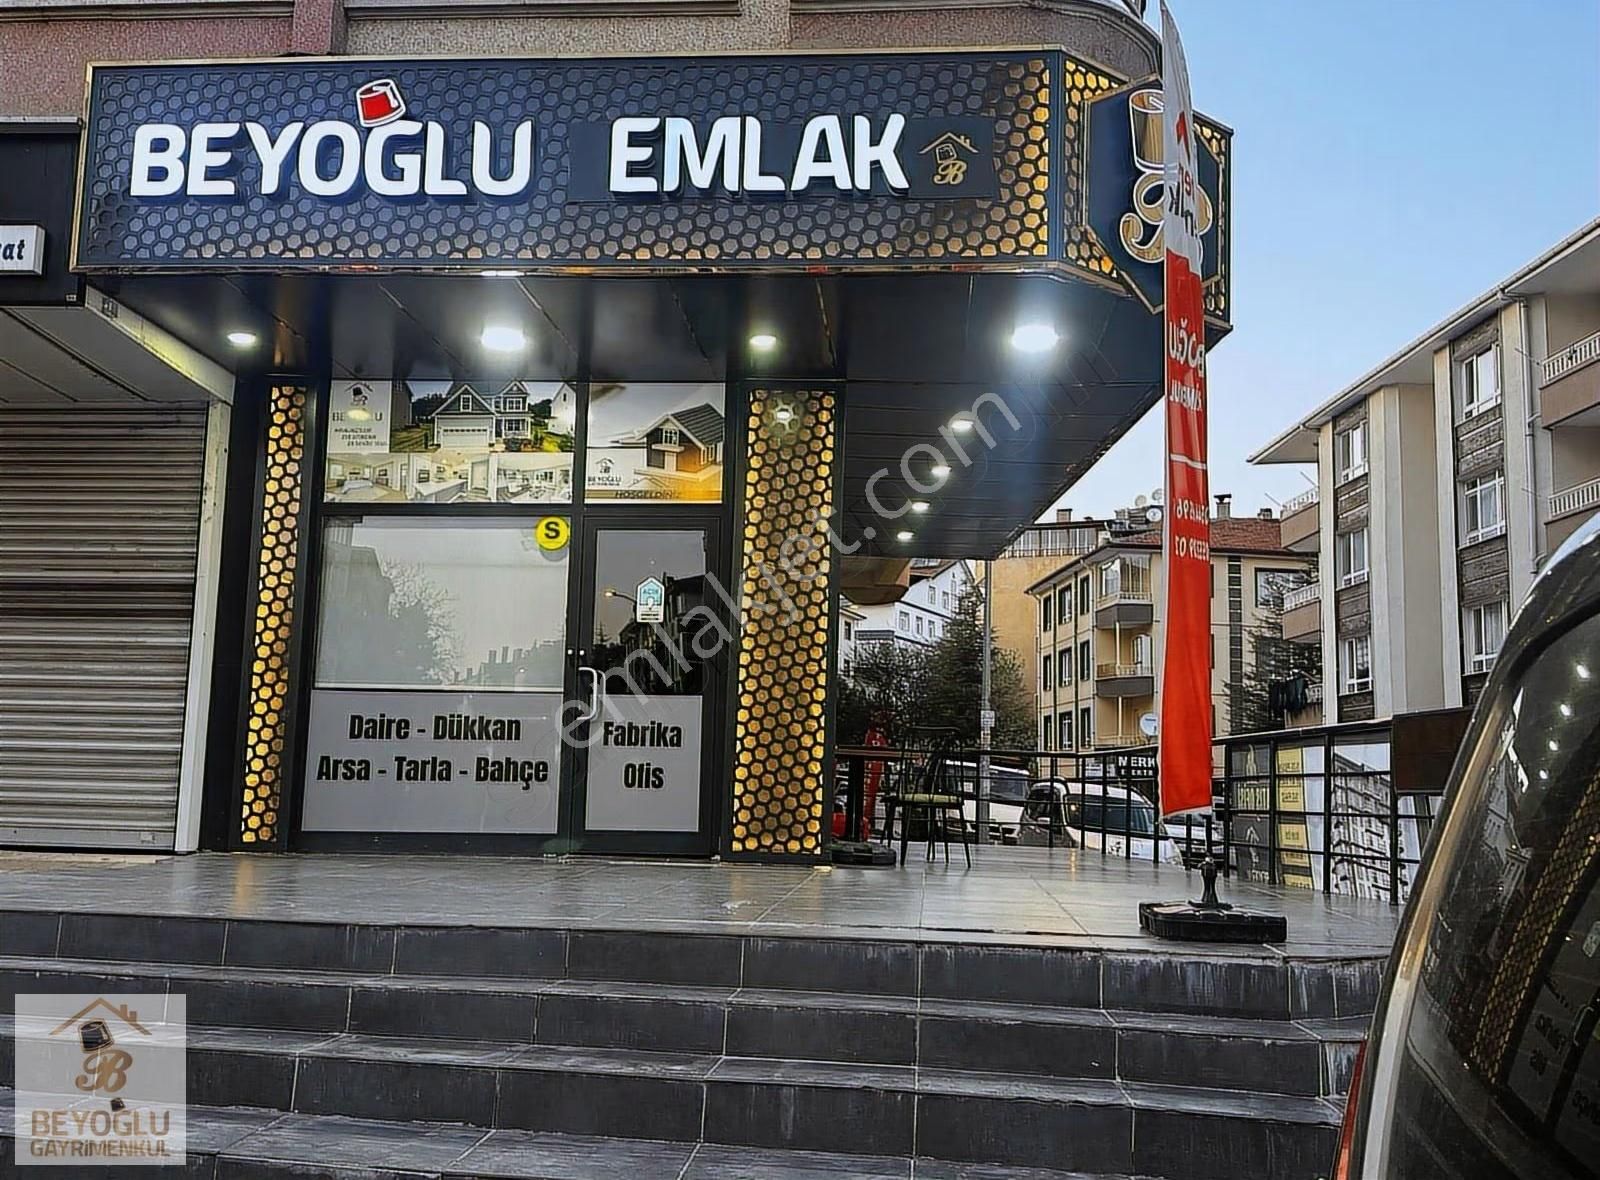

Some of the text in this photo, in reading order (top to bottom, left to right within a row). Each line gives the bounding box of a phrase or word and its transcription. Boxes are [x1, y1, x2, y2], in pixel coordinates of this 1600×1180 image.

[609, 113, 910, 192] EMLAK
[0, 239, 25, 260] at
[544, 521, 560, 539] S
[349, 714, 410, 741] Daire
[433, 714, 521, 741] Dükkan
[602, 720, 682, 748] Fabrika
[317, 755, 370, 781] Arsa
[395, 756, 452, 782] Tarla
[475, 757, 549, 791] Bahçe
